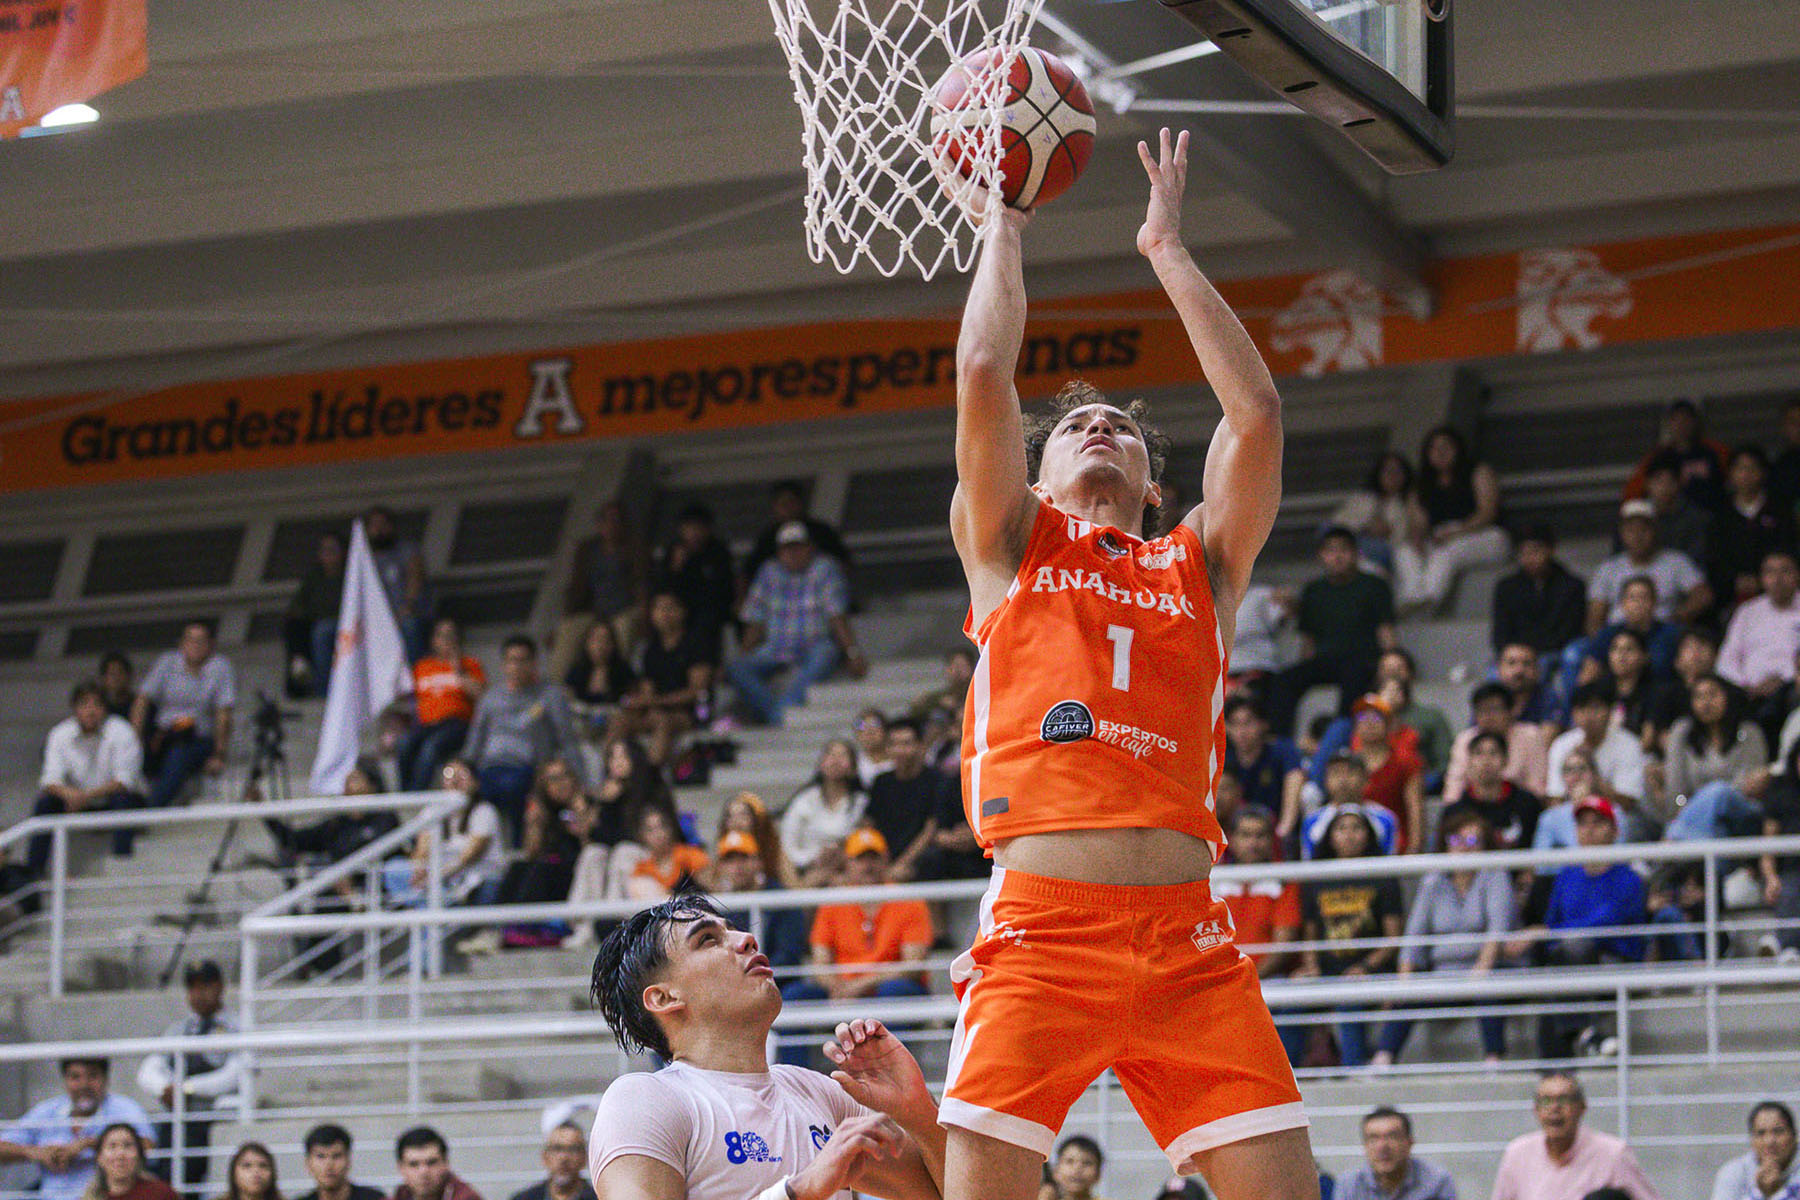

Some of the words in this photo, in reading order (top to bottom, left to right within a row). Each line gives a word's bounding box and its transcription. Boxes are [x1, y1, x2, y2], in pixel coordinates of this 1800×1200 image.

[840, 327, 1142, 409] pernas
[1032, 566, 1196, 620] ANAHUAC
[1107, 624, 1135, 692] 1
[1045, 723, 1090, 733] CAFIVER
[1098, 729, 1121, 745] en
[1099, 719, 1179, 753] EXPERTOS
